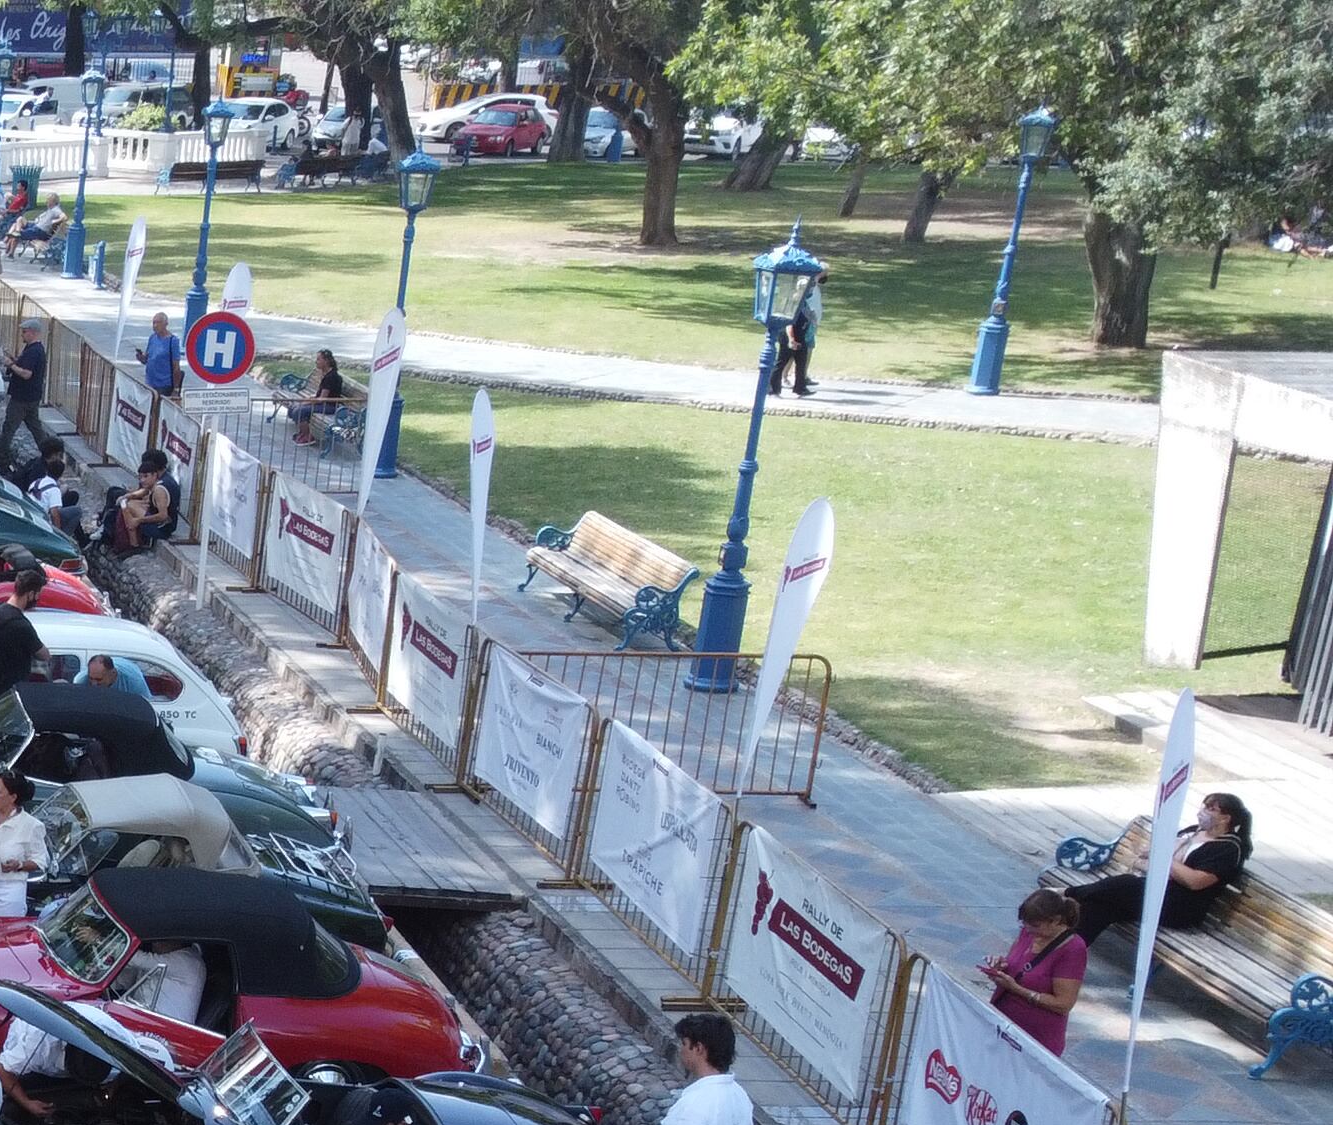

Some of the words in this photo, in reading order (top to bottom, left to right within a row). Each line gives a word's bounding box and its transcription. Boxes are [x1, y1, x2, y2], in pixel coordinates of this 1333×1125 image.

[30, 11, 67, 50] Orig
[203, 329, 237, 369] H
[184, 711, 197, 719] TC
[622, 849, 664, 896] TRAPICHE
[802, 898, 829, 927] RALLY
[830, 922, 844, 941] DE
[779, 911, 800, 940] LAS
[801, 930, 853, 985] BODEGAS
